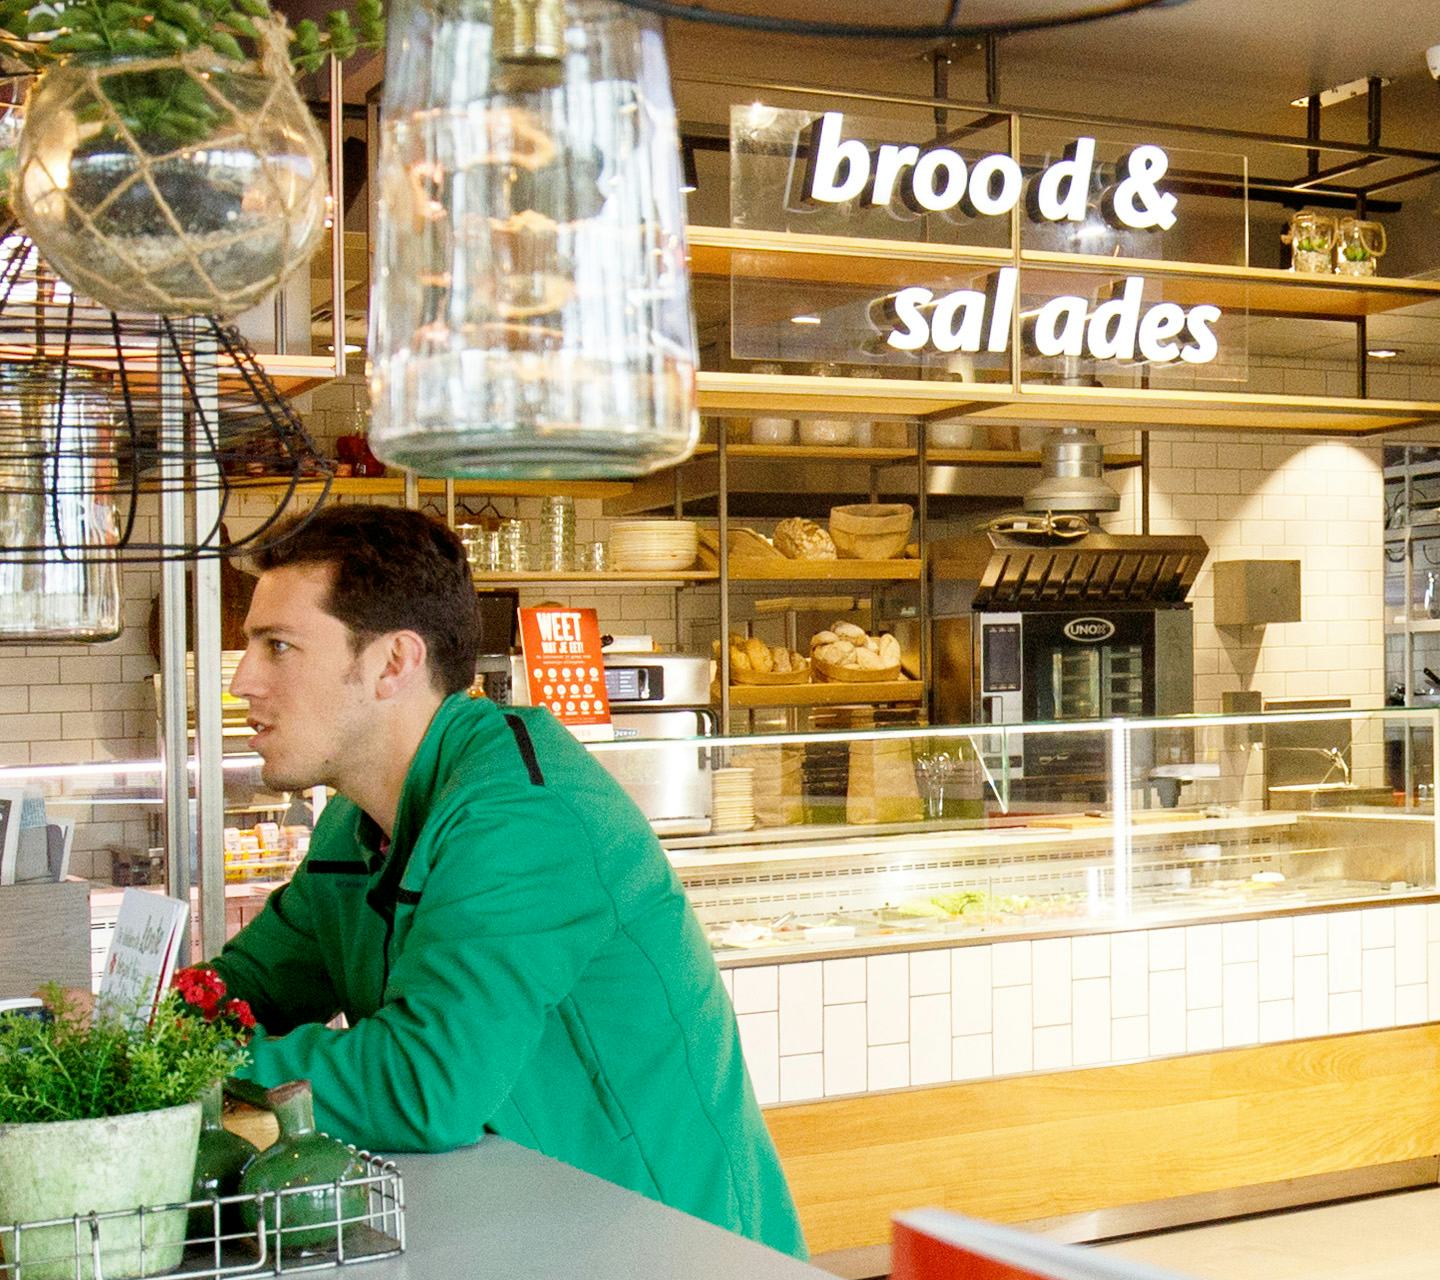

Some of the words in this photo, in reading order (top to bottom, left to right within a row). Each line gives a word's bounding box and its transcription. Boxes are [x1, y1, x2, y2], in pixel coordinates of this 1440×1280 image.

[811, 111, 1095, 221] brood
[1114, 145, 1179, 231] &
[886, 266, 1222, 365] salades
[536, 612, 582, 641] WEET
[1070, 624, 1106, 635] UNOX
